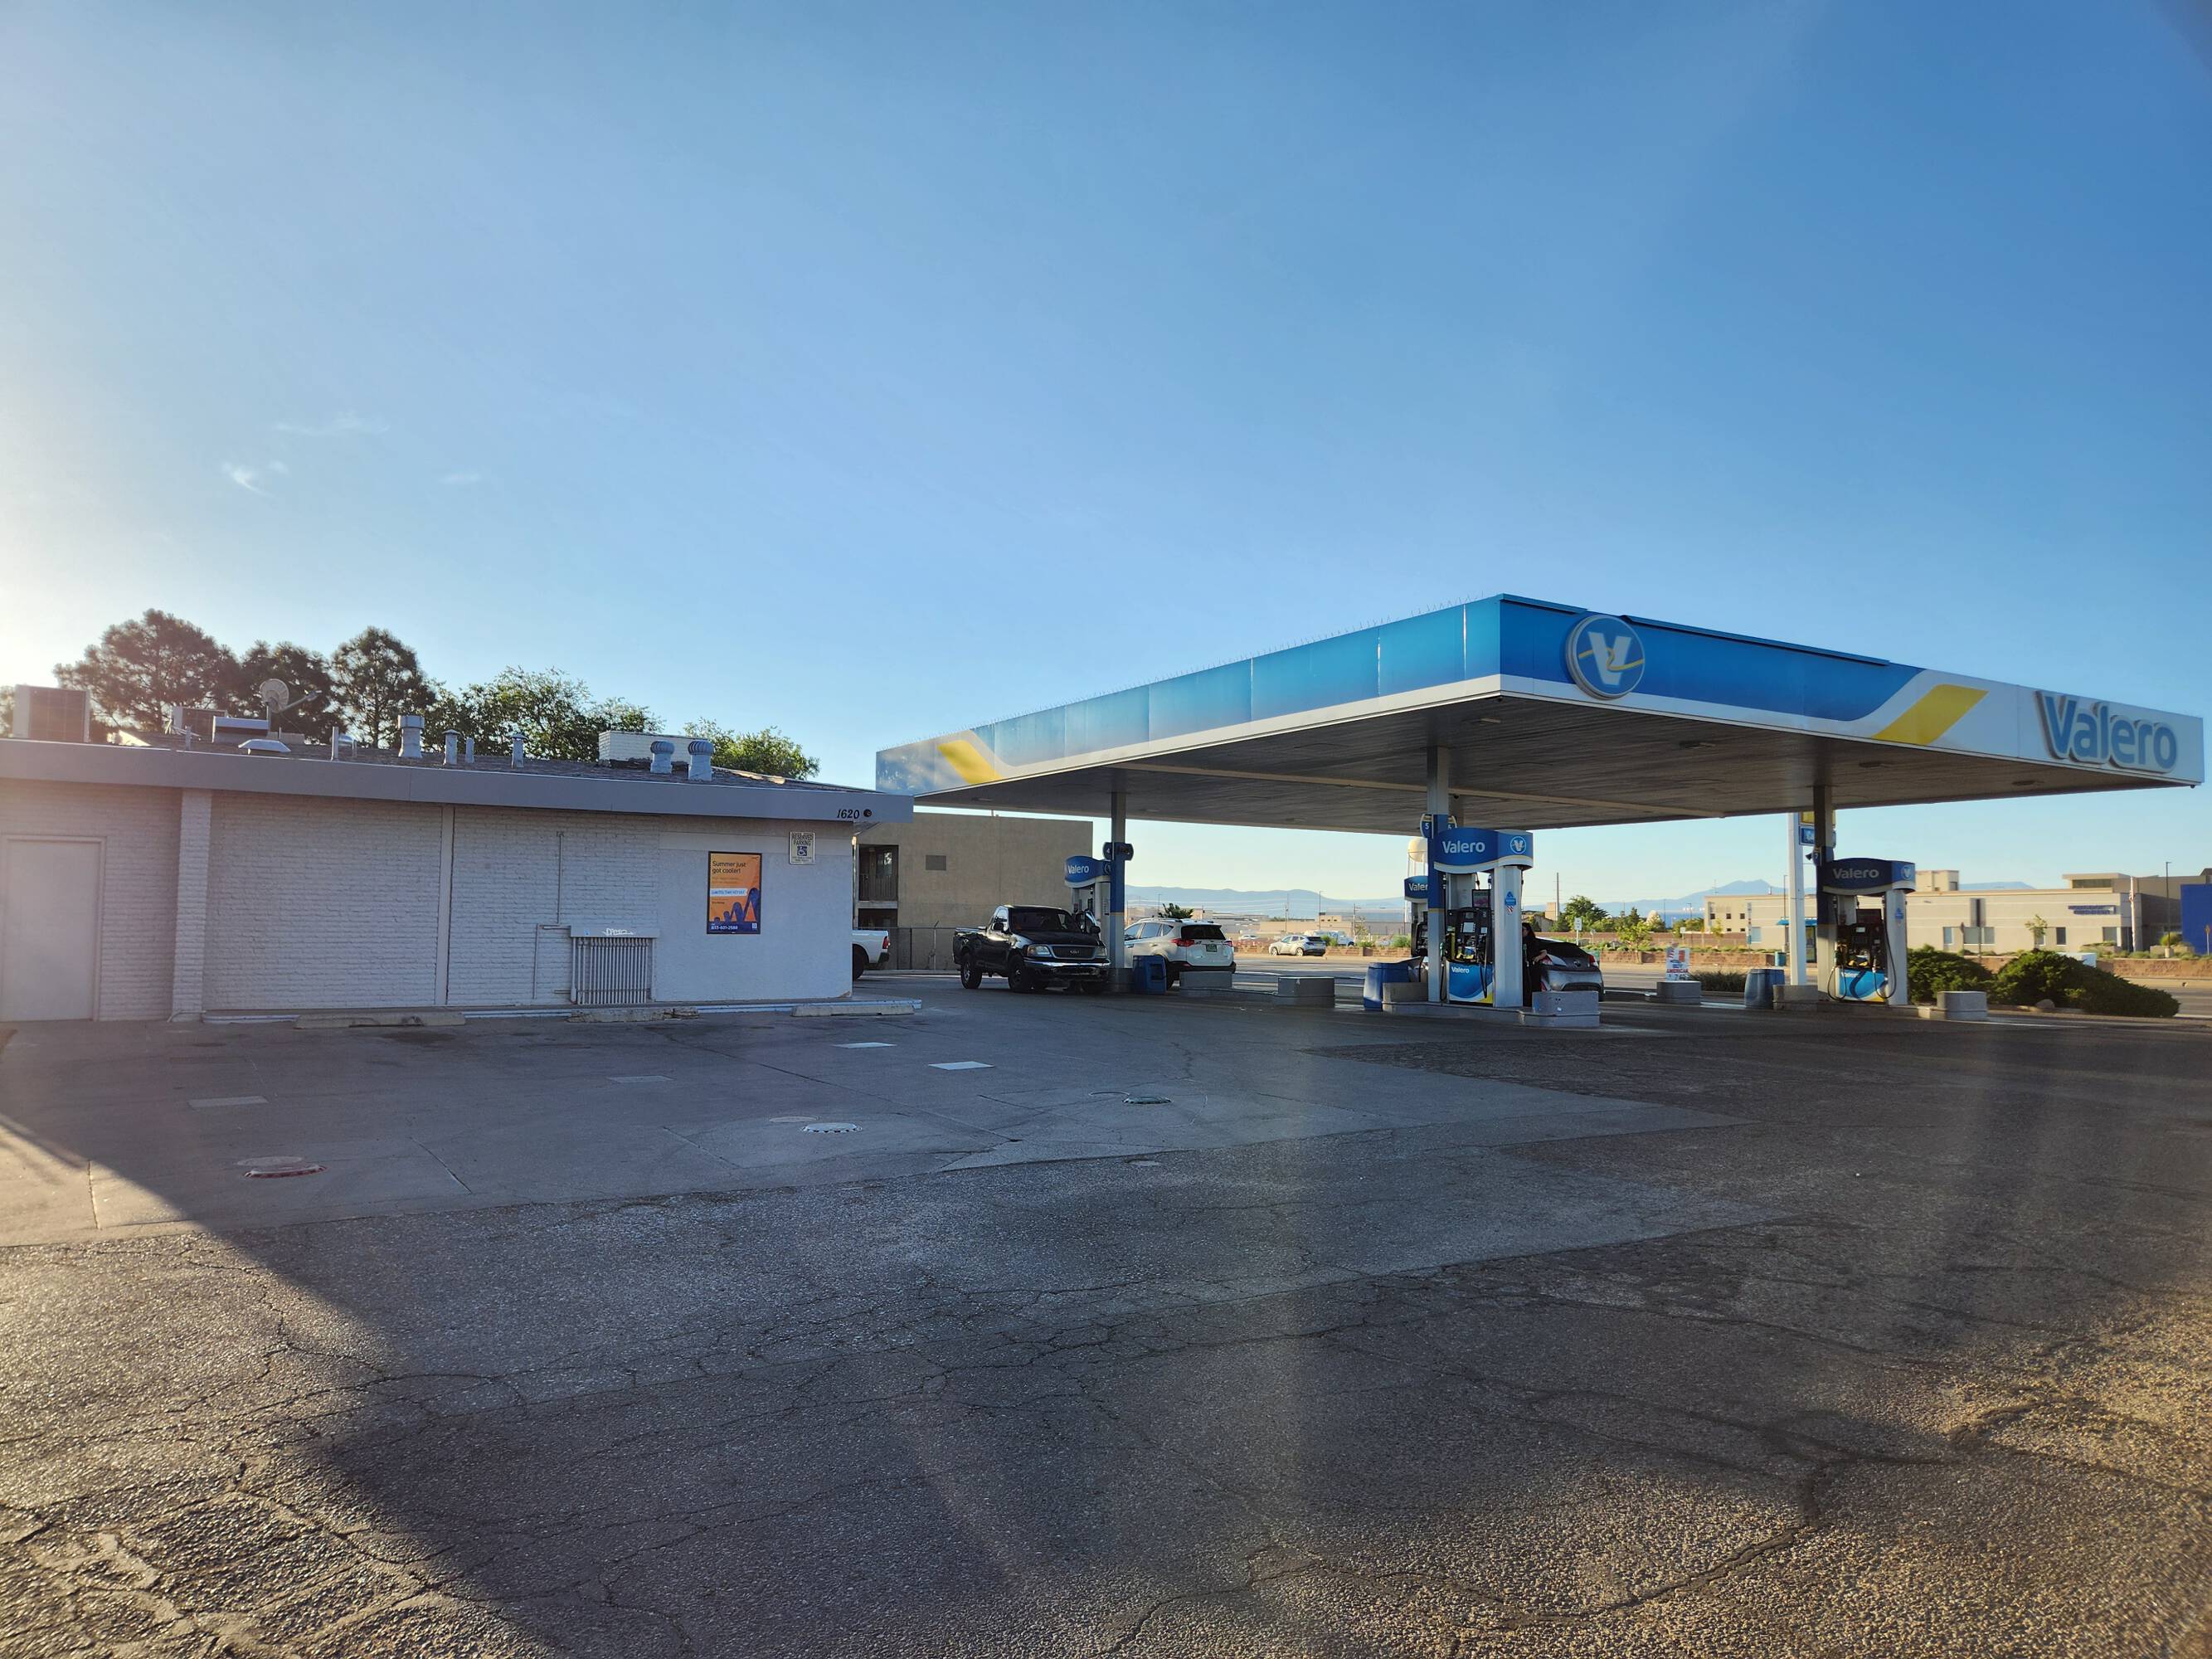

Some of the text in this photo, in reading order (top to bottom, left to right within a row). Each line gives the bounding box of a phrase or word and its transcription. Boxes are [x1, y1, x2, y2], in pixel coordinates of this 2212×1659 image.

[2044, 695, 2177, 769] Valero
[837, 809, 860, 819] 1620
[1442, 840, 1485, 854] Valero
[1067, 864, 1089, 874] Valero
[1832, 868, 1879, 879] Valero
[1408, 883, 1428, 891] Valer
[1451, 966, 1470, 974] Valero
